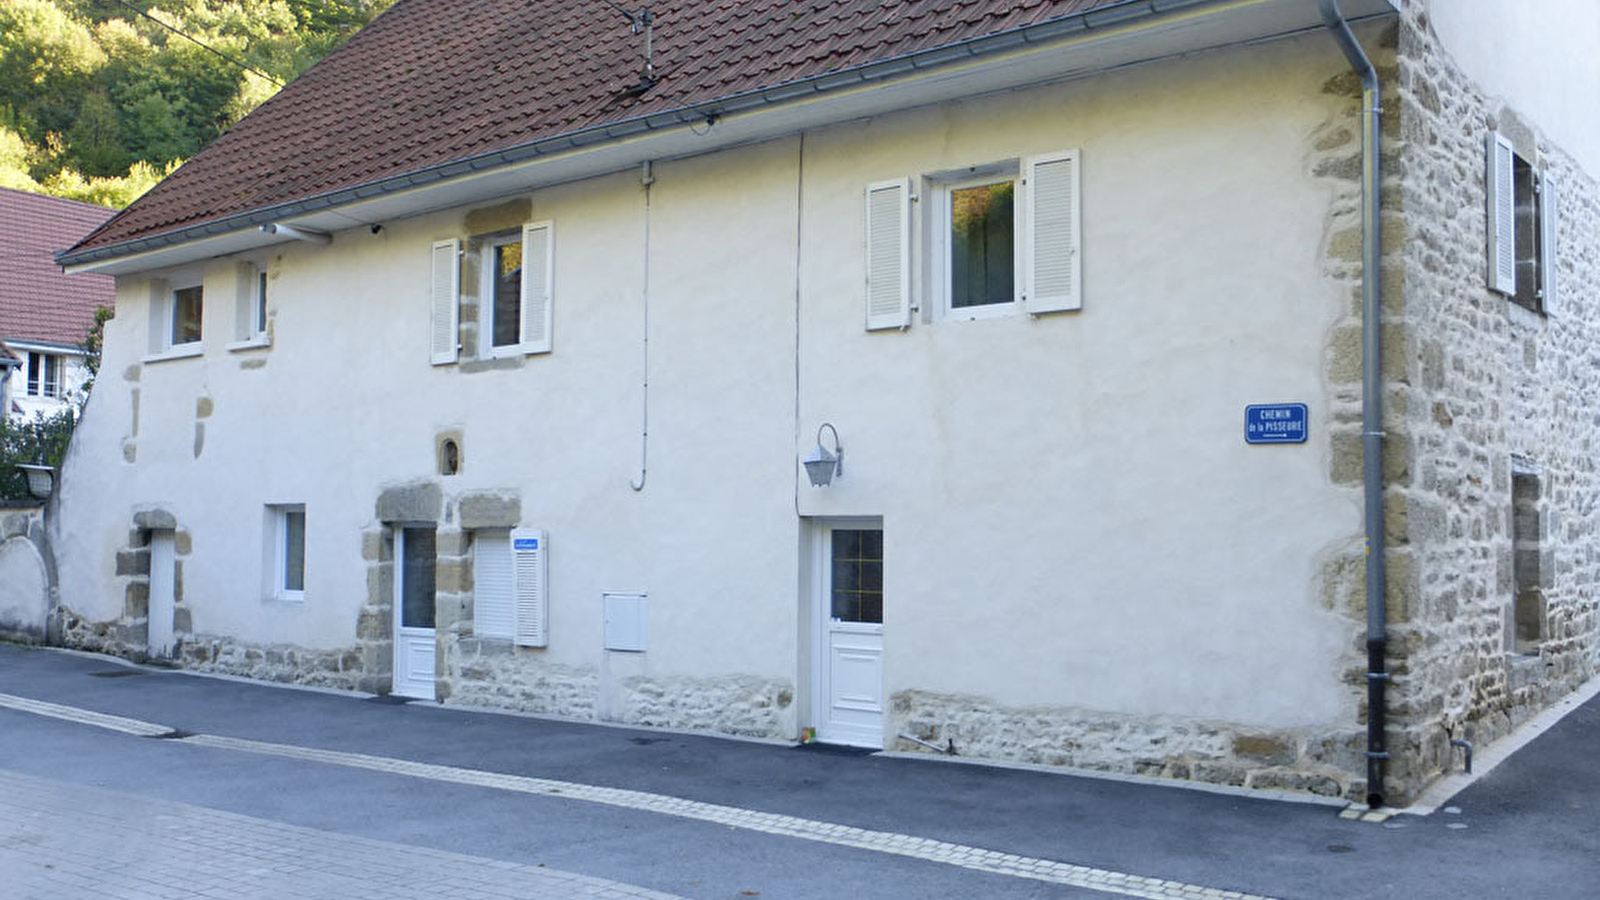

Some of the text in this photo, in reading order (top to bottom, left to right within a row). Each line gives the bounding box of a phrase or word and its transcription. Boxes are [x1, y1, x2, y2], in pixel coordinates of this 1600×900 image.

[1260, 410, 1291, 420] CHEMIN
[1249, 421, 1302, 432] de la PISSEURE
